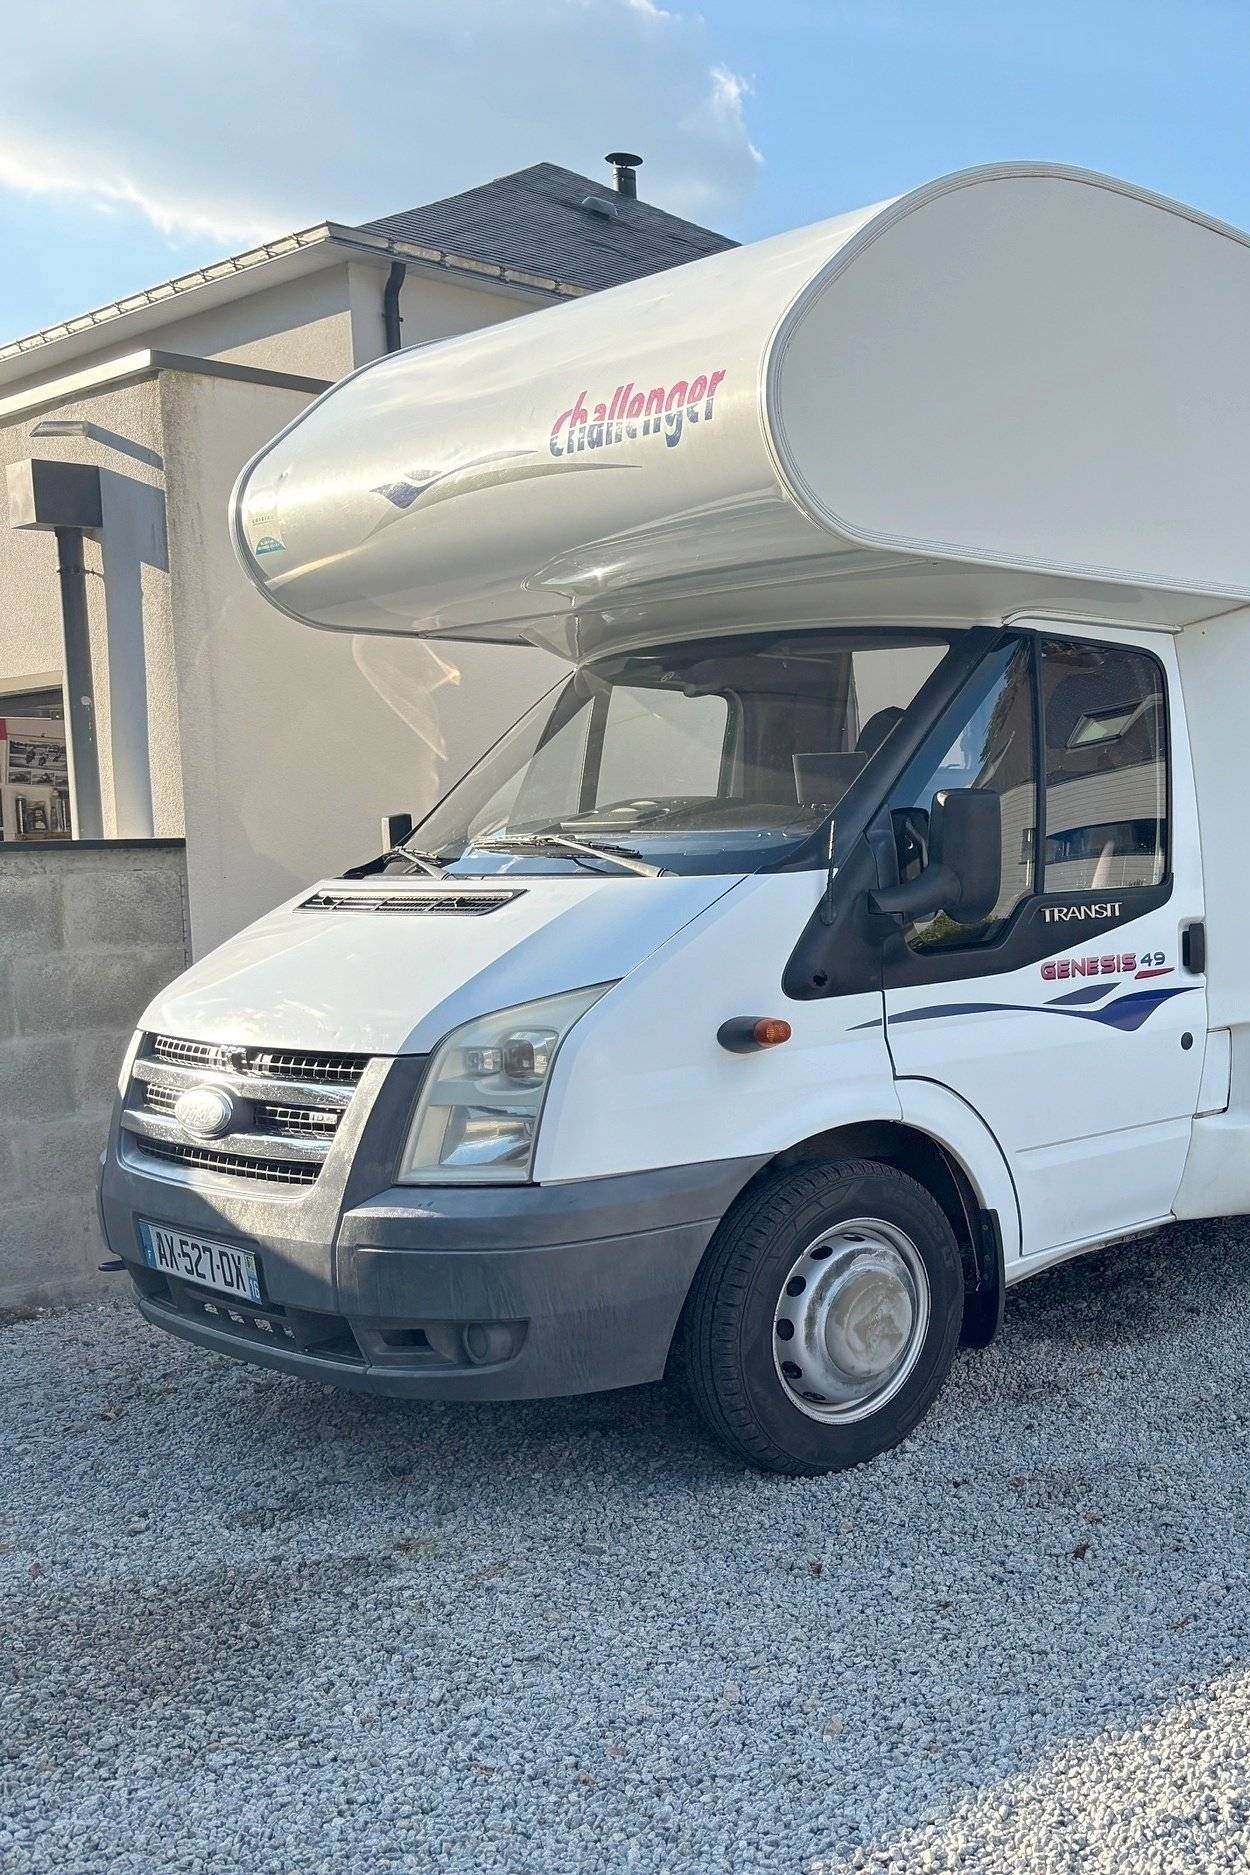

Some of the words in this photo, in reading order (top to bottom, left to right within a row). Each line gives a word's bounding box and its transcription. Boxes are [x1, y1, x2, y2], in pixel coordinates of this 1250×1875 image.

[1041, 902, 1123, 923] TRANSIT
[1040, 953, 1137, 981] GENESIS
[1140, 951, 1166, 967] 49
